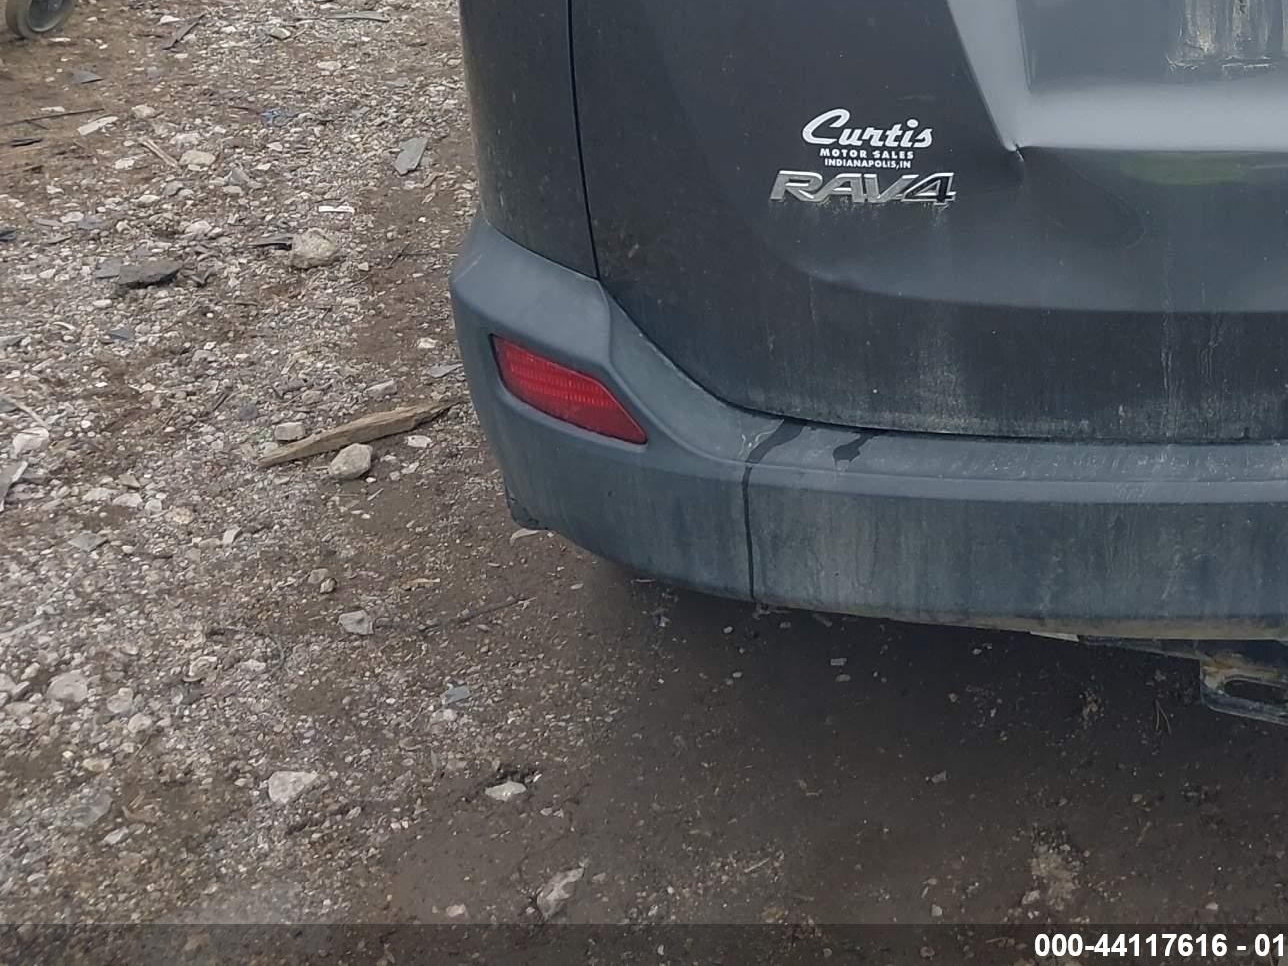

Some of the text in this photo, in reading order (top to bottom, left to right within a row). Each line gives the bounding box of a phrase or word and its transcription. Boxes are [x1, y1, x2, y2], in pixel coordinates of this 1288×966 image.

[801, 108, 934, 149] Curtis
[819, 148, 915, 159] MOTOR SALES
[769, 170, 957, 206] RAV4
